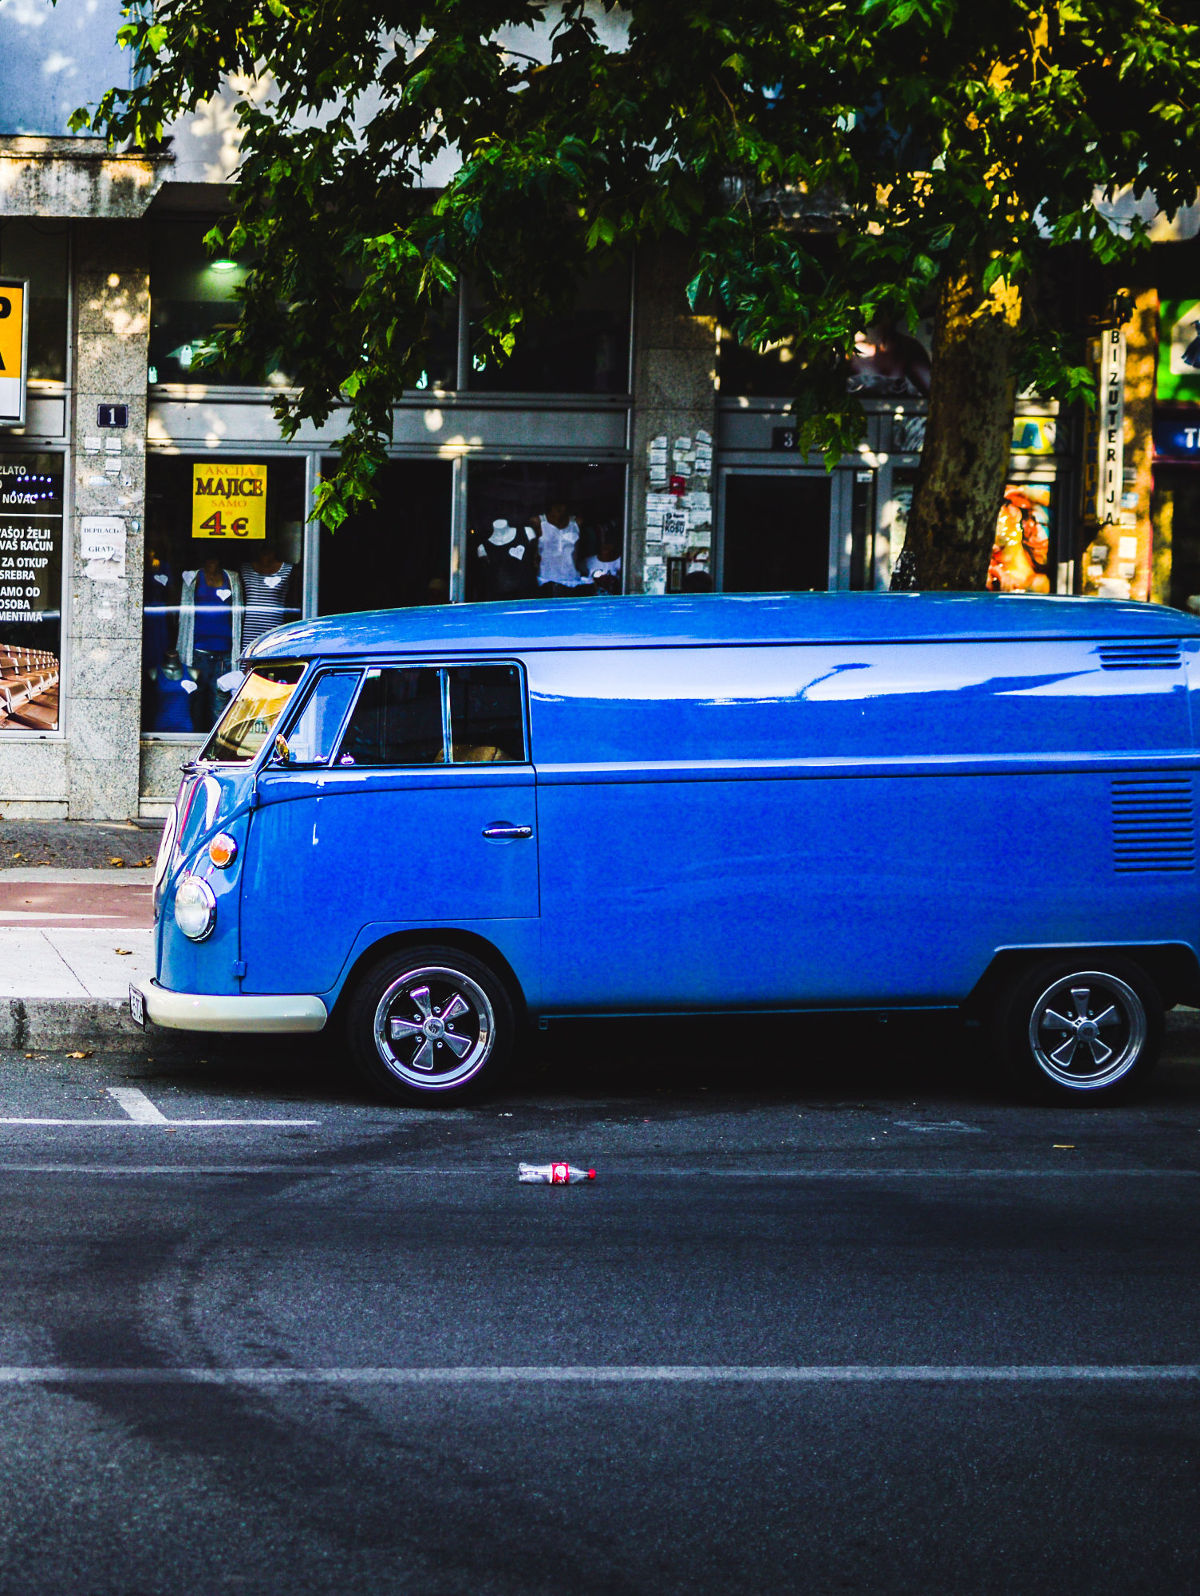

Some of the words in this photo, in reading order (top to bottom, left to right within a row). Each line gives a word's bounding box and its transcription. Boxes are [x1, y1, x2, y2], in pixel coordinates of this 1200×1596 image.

[108, 408, 117, 425] 1
[1106, 331, 1120, 525] BIZUTERIJA
[784, 432, 793, 448] 3
[206, 466, 255, 476] AKCIJA
[195, 478, 263, 500] MAJICE
[2, 494, 37, 505] NOVAC
[200, 511, 226, 536] 4
[231, 517, 248, 536] €
[27, 526, 50, 539] ŽELJI
[0, 538, 18, 551] VAŠ
[20, 539, 53, 552] RAČUN
[2, 557, 14, 567] ZA
[16, 557, 48, 568] OTKUP
[0, 570, 35, 580] SREBRA
[25, 587, 40, 597] OD
